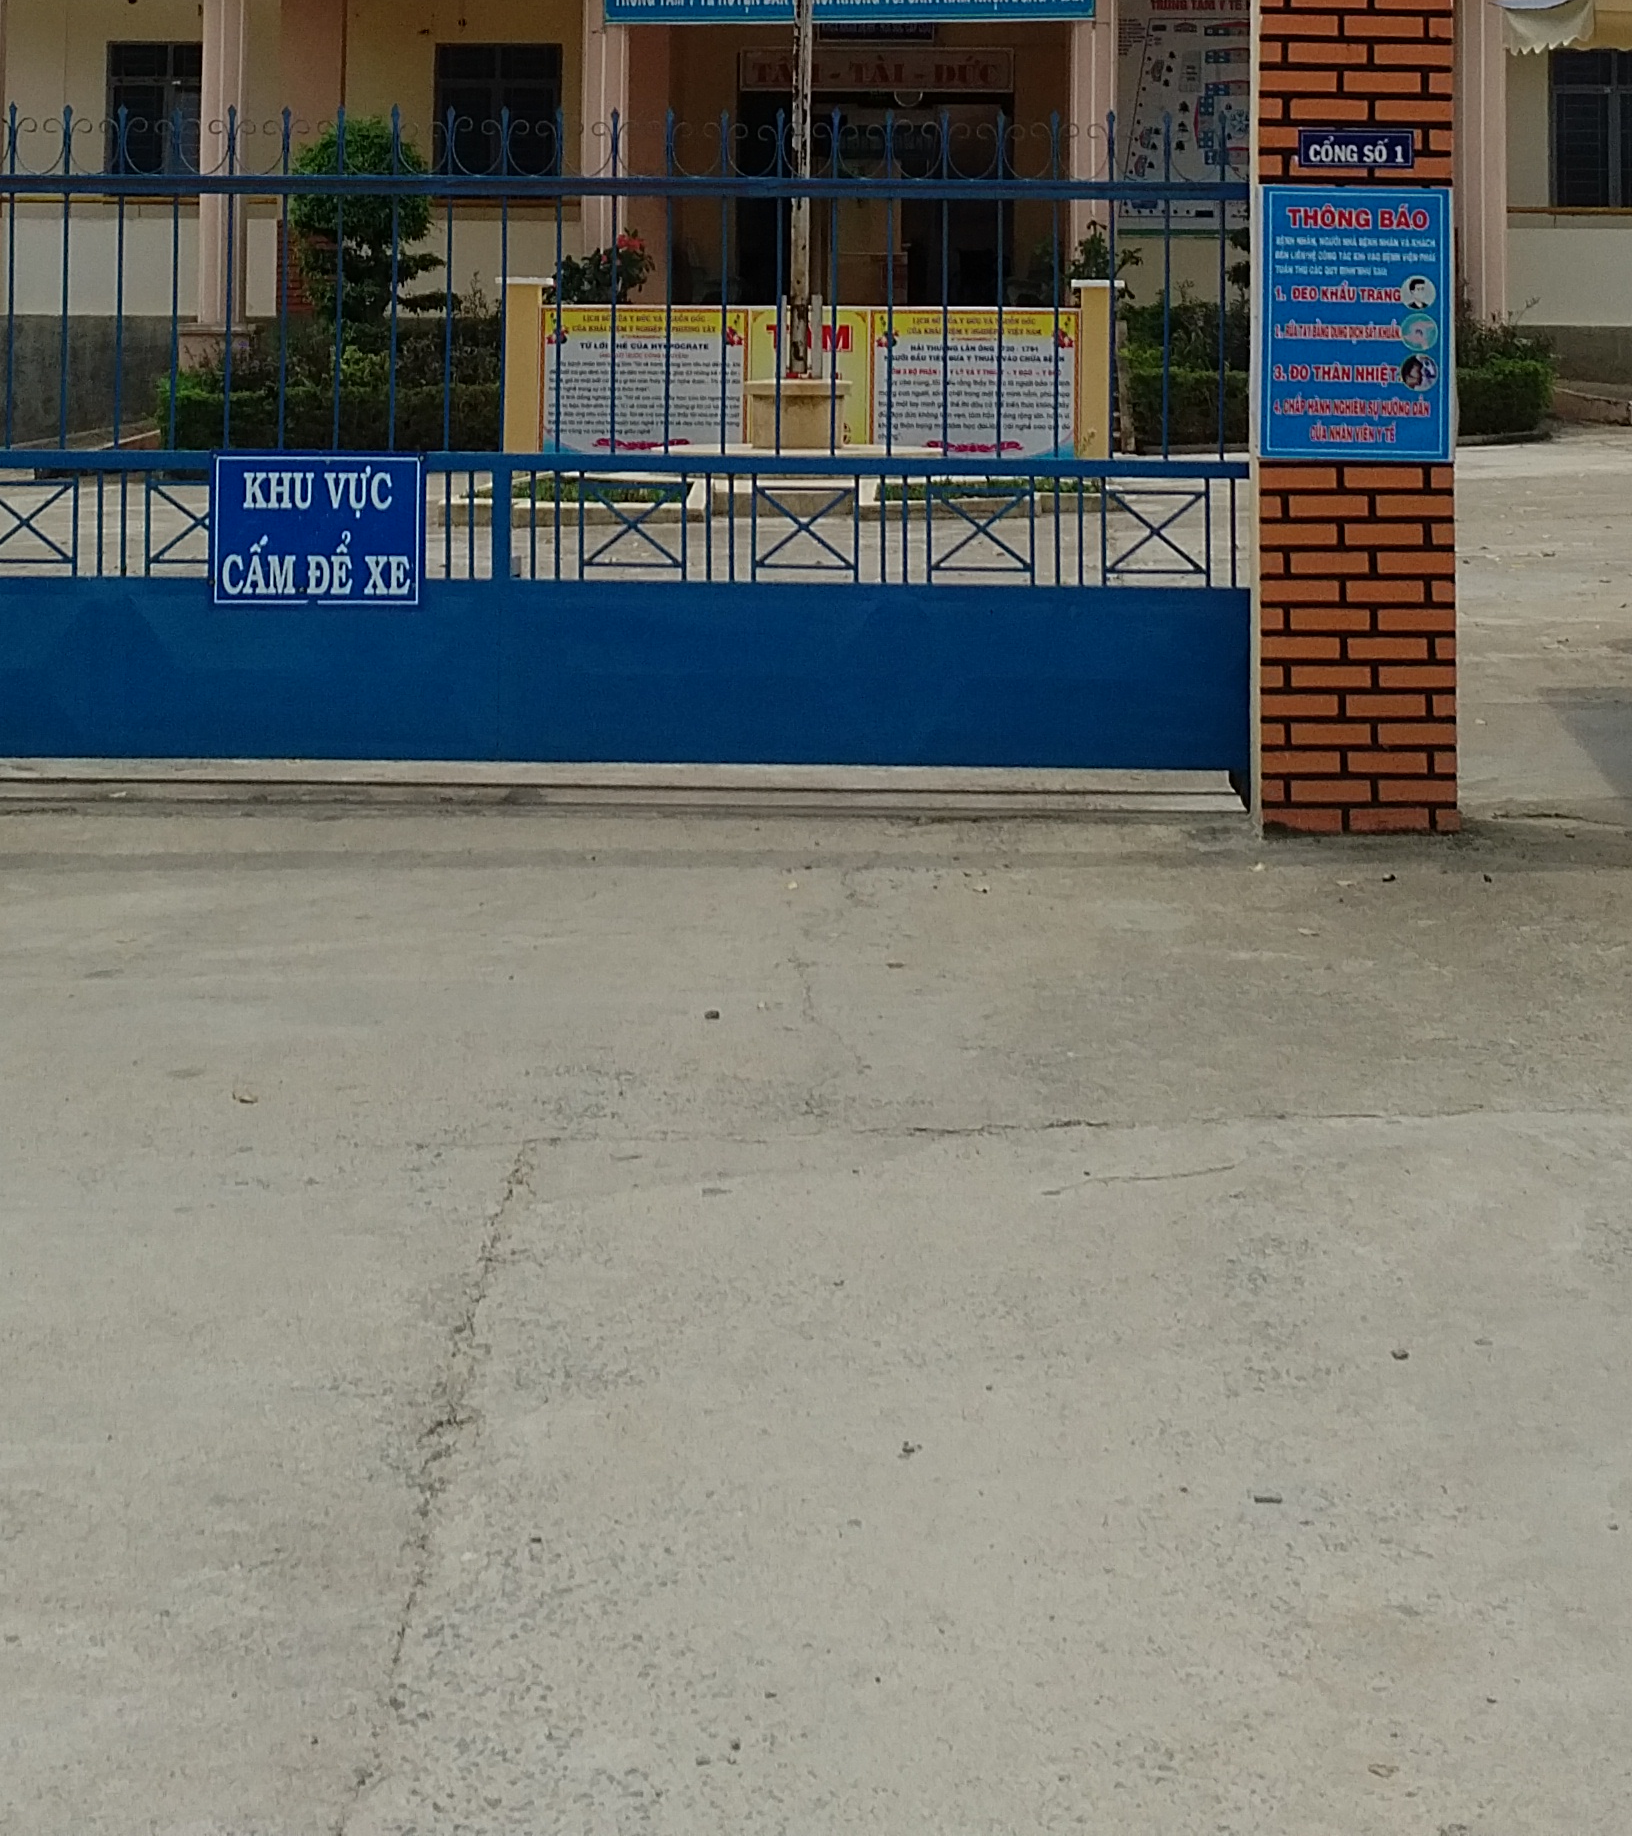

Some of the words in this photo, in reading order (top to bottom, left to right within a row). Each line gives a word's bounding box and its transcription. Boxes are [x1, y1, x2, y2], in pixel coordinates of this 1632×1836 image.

[1309, 135, 1358, 163] CỔNG
[1363, 137, 1388, 163] SỐ
[1394, 145, 1405, 163] 1
[1287, 203, 1371, 229] THÔNG
[1378, 203, 1430, 231] BÁO
[1275, 286, 1286, 301] 1.
[1291, 286, 1317, 301] ĐEO
[1320, 280, 1357, 302] KHẨU
[1359, 287, 1401, 303] TRANG
[766, 324, 854, 353] TM
[1273, 364, 1286, 381] 3.
[1289, 364, 1310, 382] ĐO
[1312, 361, 1352, 382] THÂN
[243, 471, 314, 510] KHU
[324, 465, 393, 519] VỰC
[222, 535, 296, 595] CẤM
[307, 530, 353, 595] ĐỂ
[364, 555, 411, 595] XE
